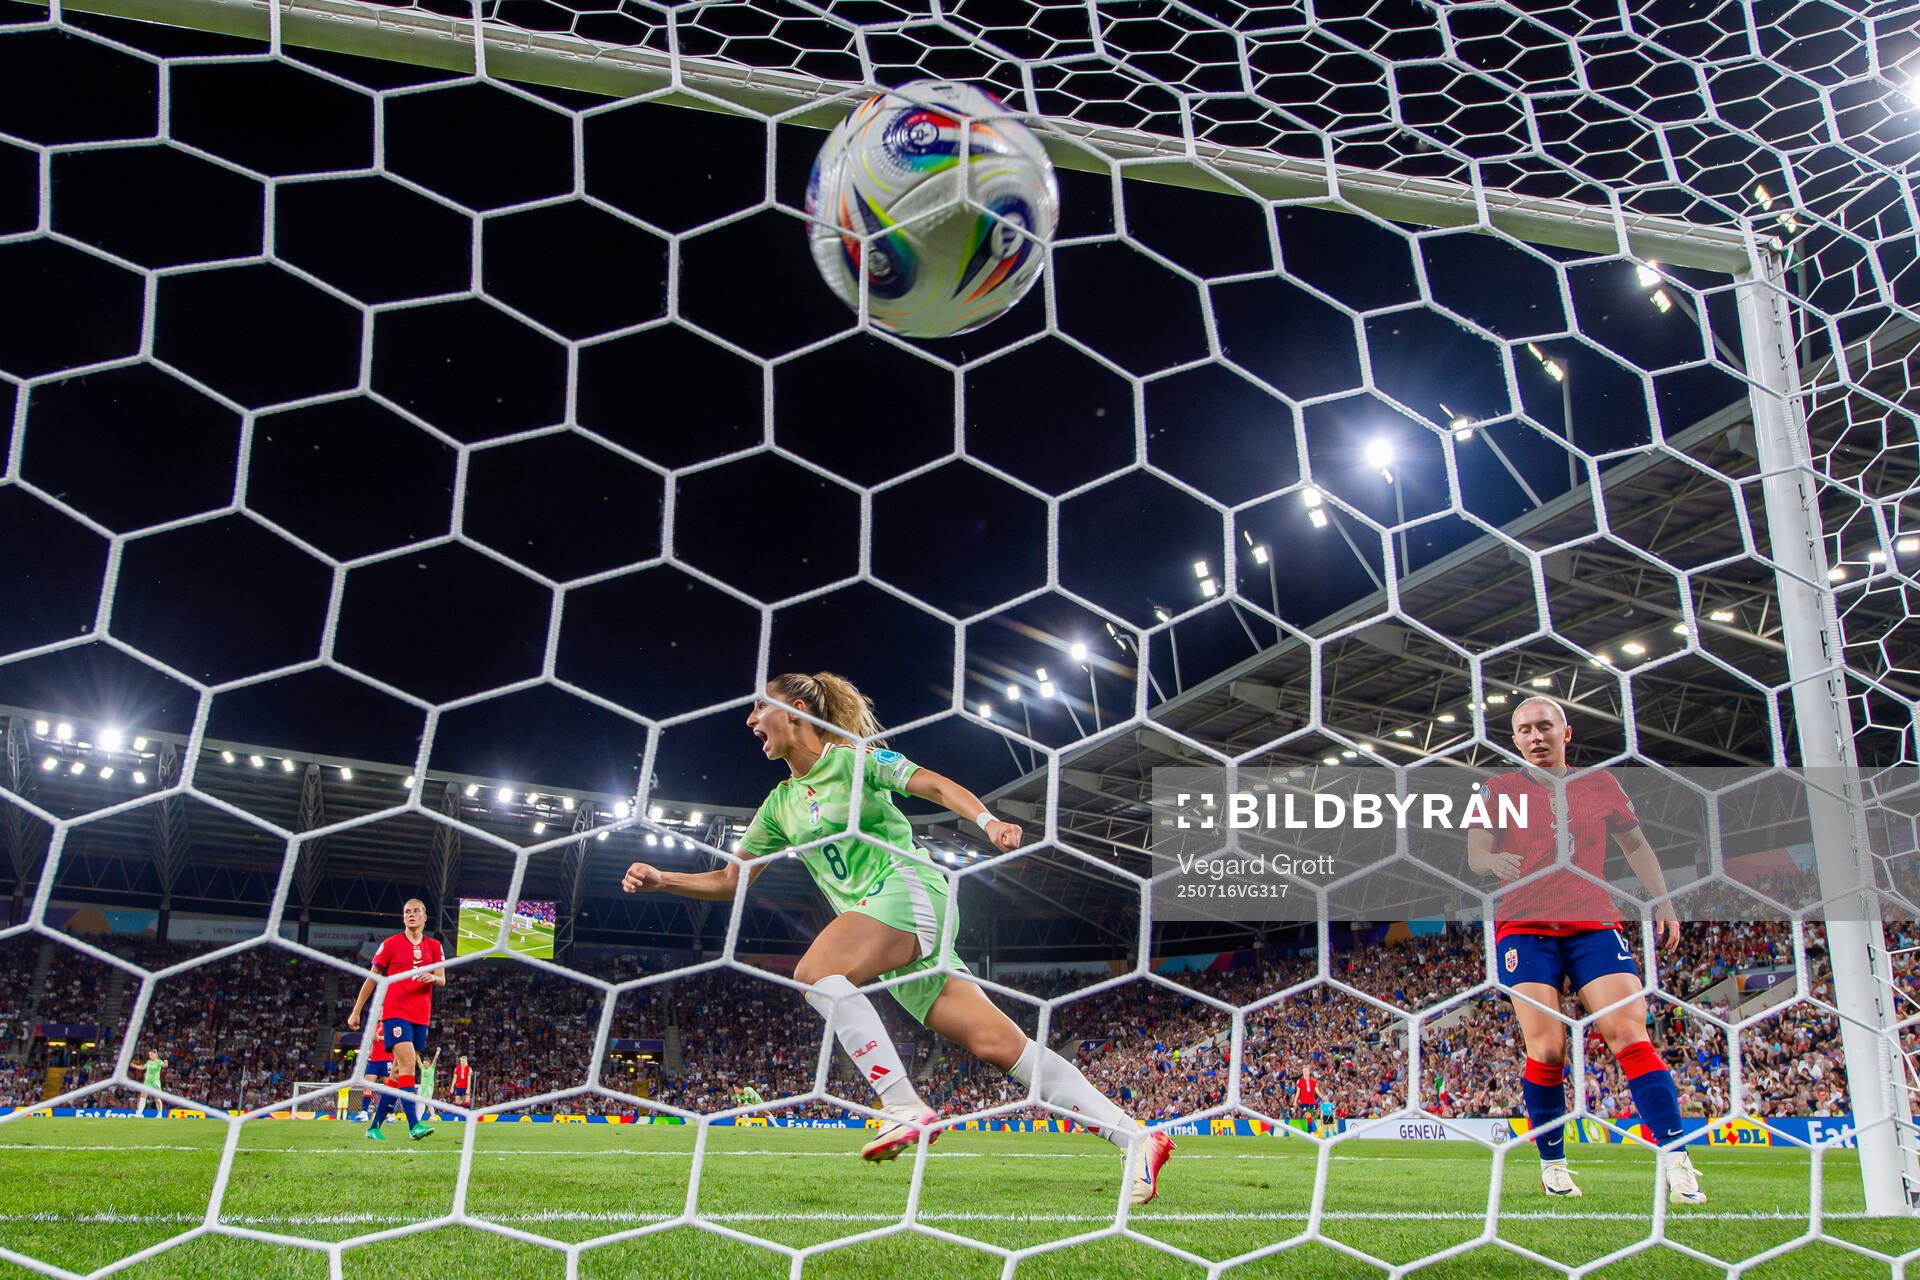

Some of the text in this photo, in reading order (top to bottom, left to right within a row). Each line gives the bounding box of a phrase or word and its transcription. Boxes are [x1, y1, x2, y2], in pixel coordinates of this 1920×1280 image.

[822, 843, 848, 881] 8
[787, 1119, 847, 1128] Eat fresh
[1400, 1124, 1447, 1140] GENEVA
[1807, 1120, 1856, 1149] Eat
